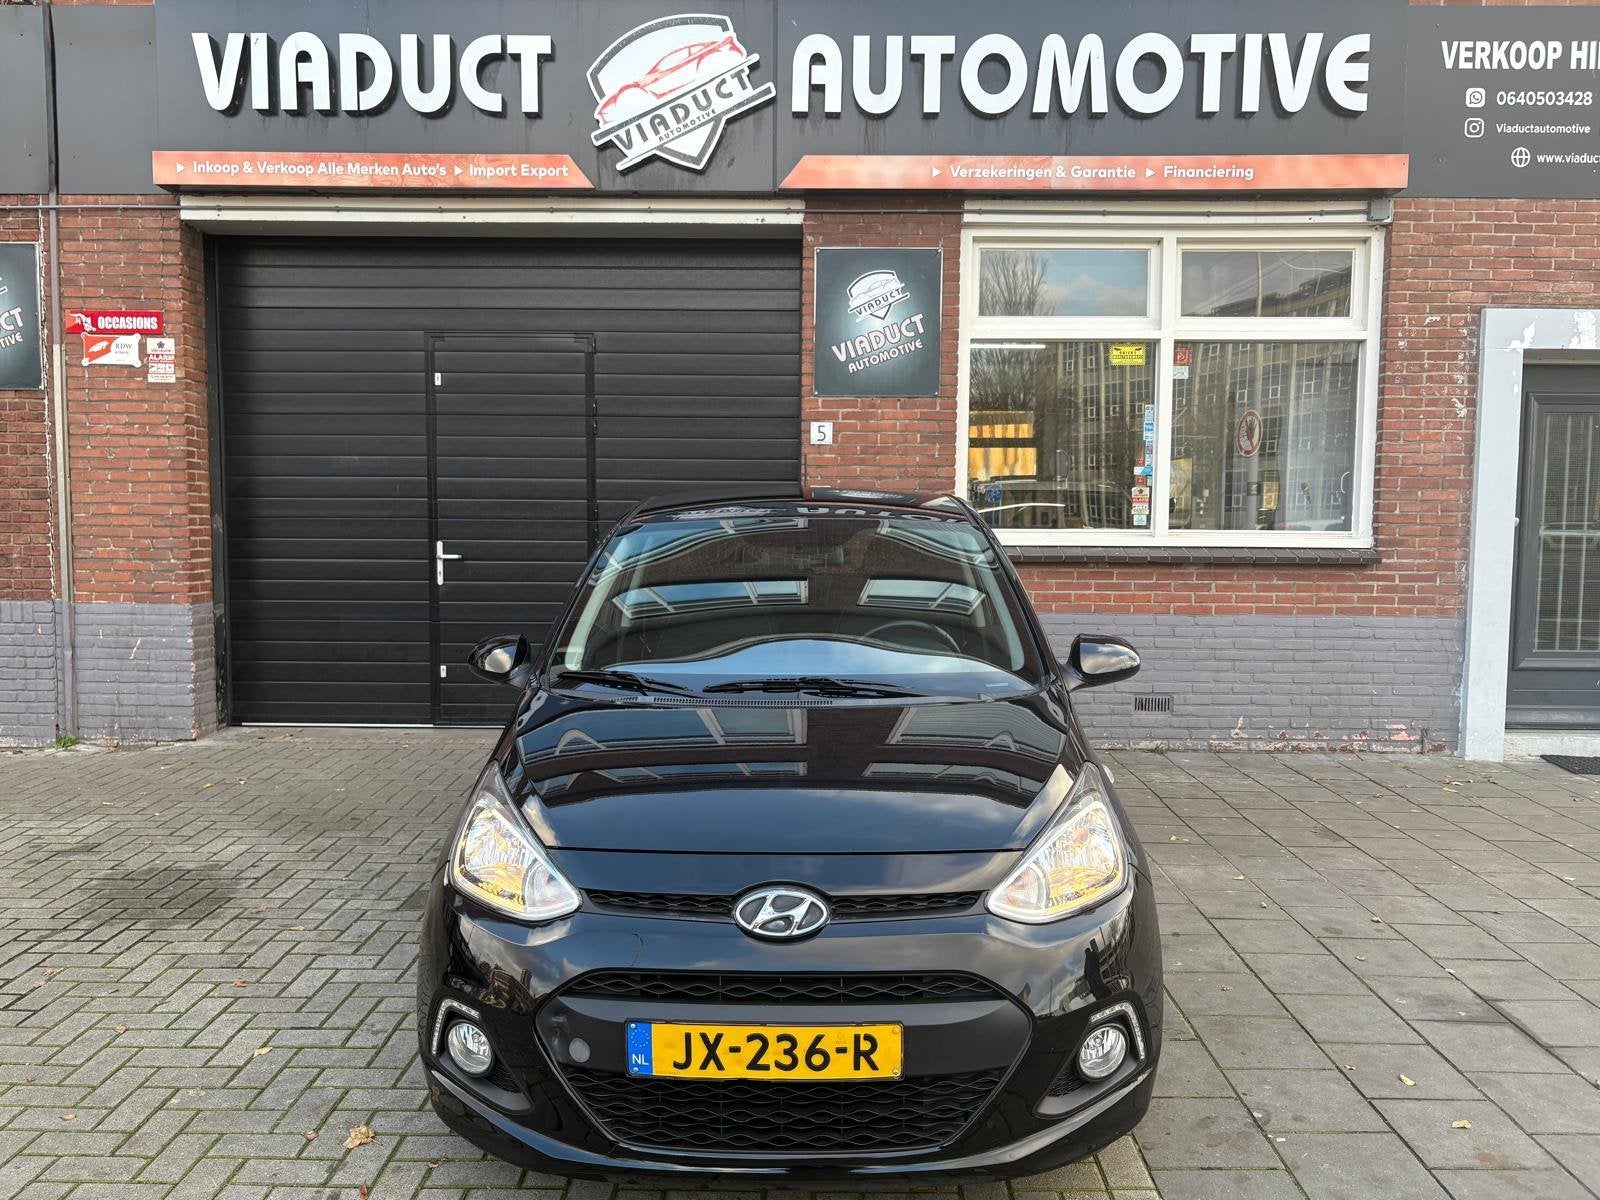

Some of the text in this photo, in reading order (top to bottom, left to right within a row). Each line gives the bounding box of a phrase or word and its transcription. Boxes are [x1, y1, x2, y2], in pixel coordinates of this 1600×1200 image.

[1441, 40, 1600, 70] VERKOOP HI
[191, 31, 552, 113] VIADUCT
[791, 32, 1371, 116] AUTOMOTIVE
[613, 67, 749, 151] VIADUCT
[1496, 91, 1593, 106] 0640503428
[658, 108, 717, 143] AUTOMOTIVE
[1496, 123, 1591, 134] Viaductautomotive
[193, 161, 447, 177] Inkoop & Verkoop Alle Merken Auto's
[469, 164, 568, 179] Import Export
[949, 165, 1136, 179] Verzekeringen & Garantie
[1163, 165, 1254, 180] Financiering
[856, 288, 902, 315] VIADUCT
[97, 316, 158, 330] OCCASIONS
[831, 313, 925, 362] VIADUCT
[848, 339, 923, 374] AUTOMOTIVE
[817, 425, 826, 442] 5
[632, 1053, 649, 1065] NL
[672, 1032, 880, 1071] JX-236-R
